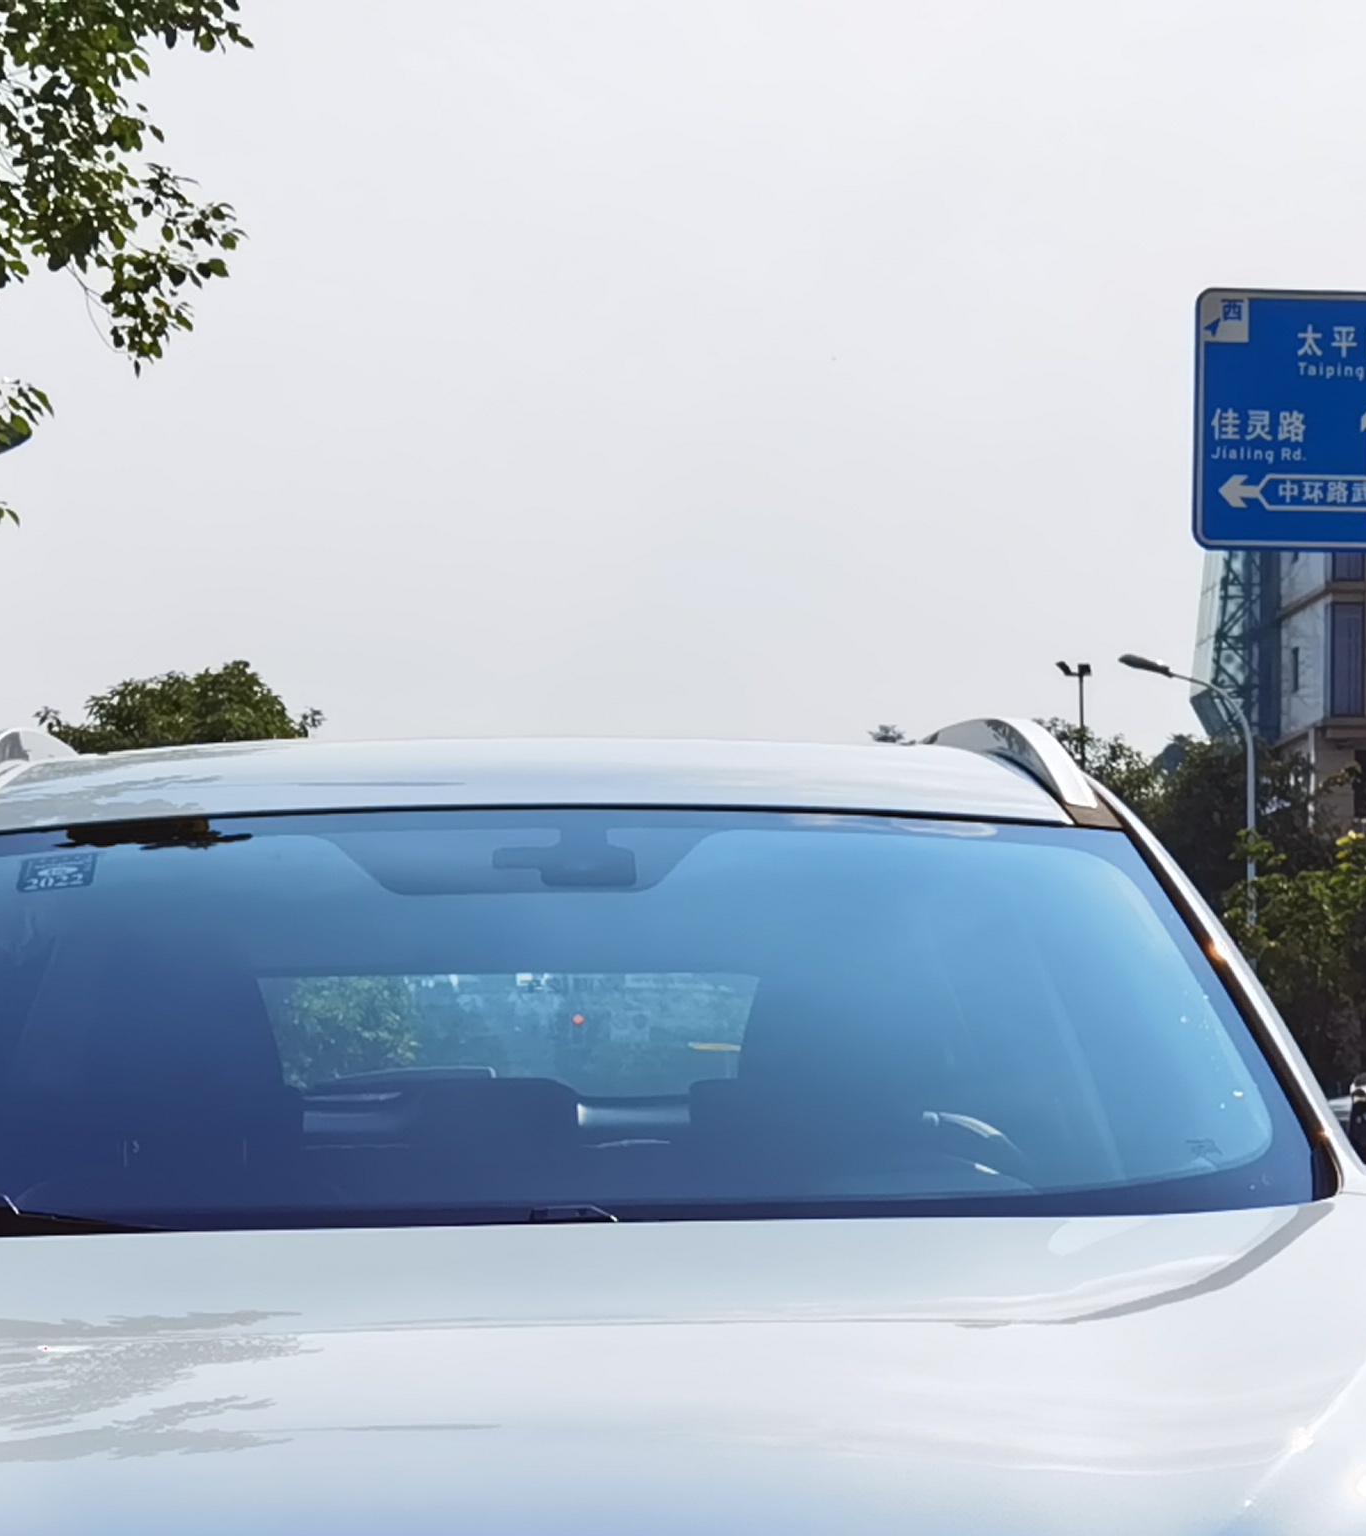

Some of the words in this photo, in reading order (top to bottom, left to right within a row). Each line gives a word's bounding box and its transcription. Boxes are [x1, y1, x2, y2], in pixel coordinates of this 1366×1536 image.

[1222, 300, 1243, 321] 西
[1210, 408, 1306, 443] 佳灵路
[1211, 447, 1274, 464] Jialing
[1281, 448, 1306, 461] Rd.
[23, 873, 84, 891] 2022
